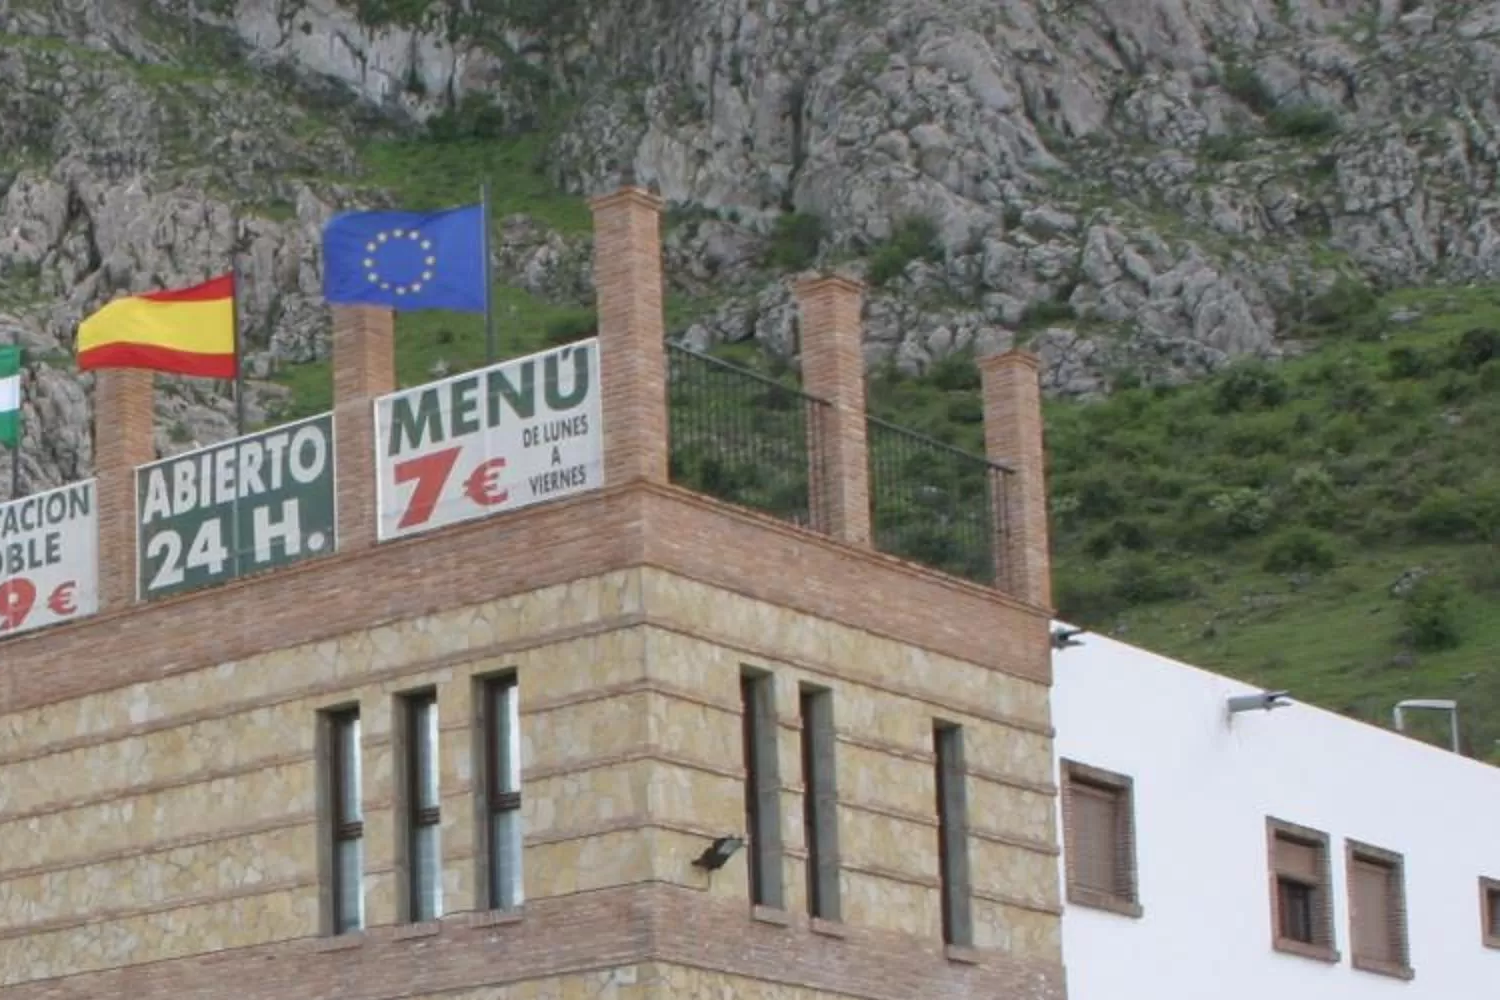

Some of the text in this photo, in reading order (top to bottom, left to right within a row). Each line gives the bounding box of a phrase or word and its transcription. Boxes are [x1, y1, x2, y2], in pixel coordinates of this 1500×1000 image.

[522, 414, 588, 448] DE LUNES
[551, 446, 561, 466] A
[143, 425, 327, 524] ABIERTO
[528, 464, 587, 496] VIERNES
[148, 498, 325, 591] 24 H.
